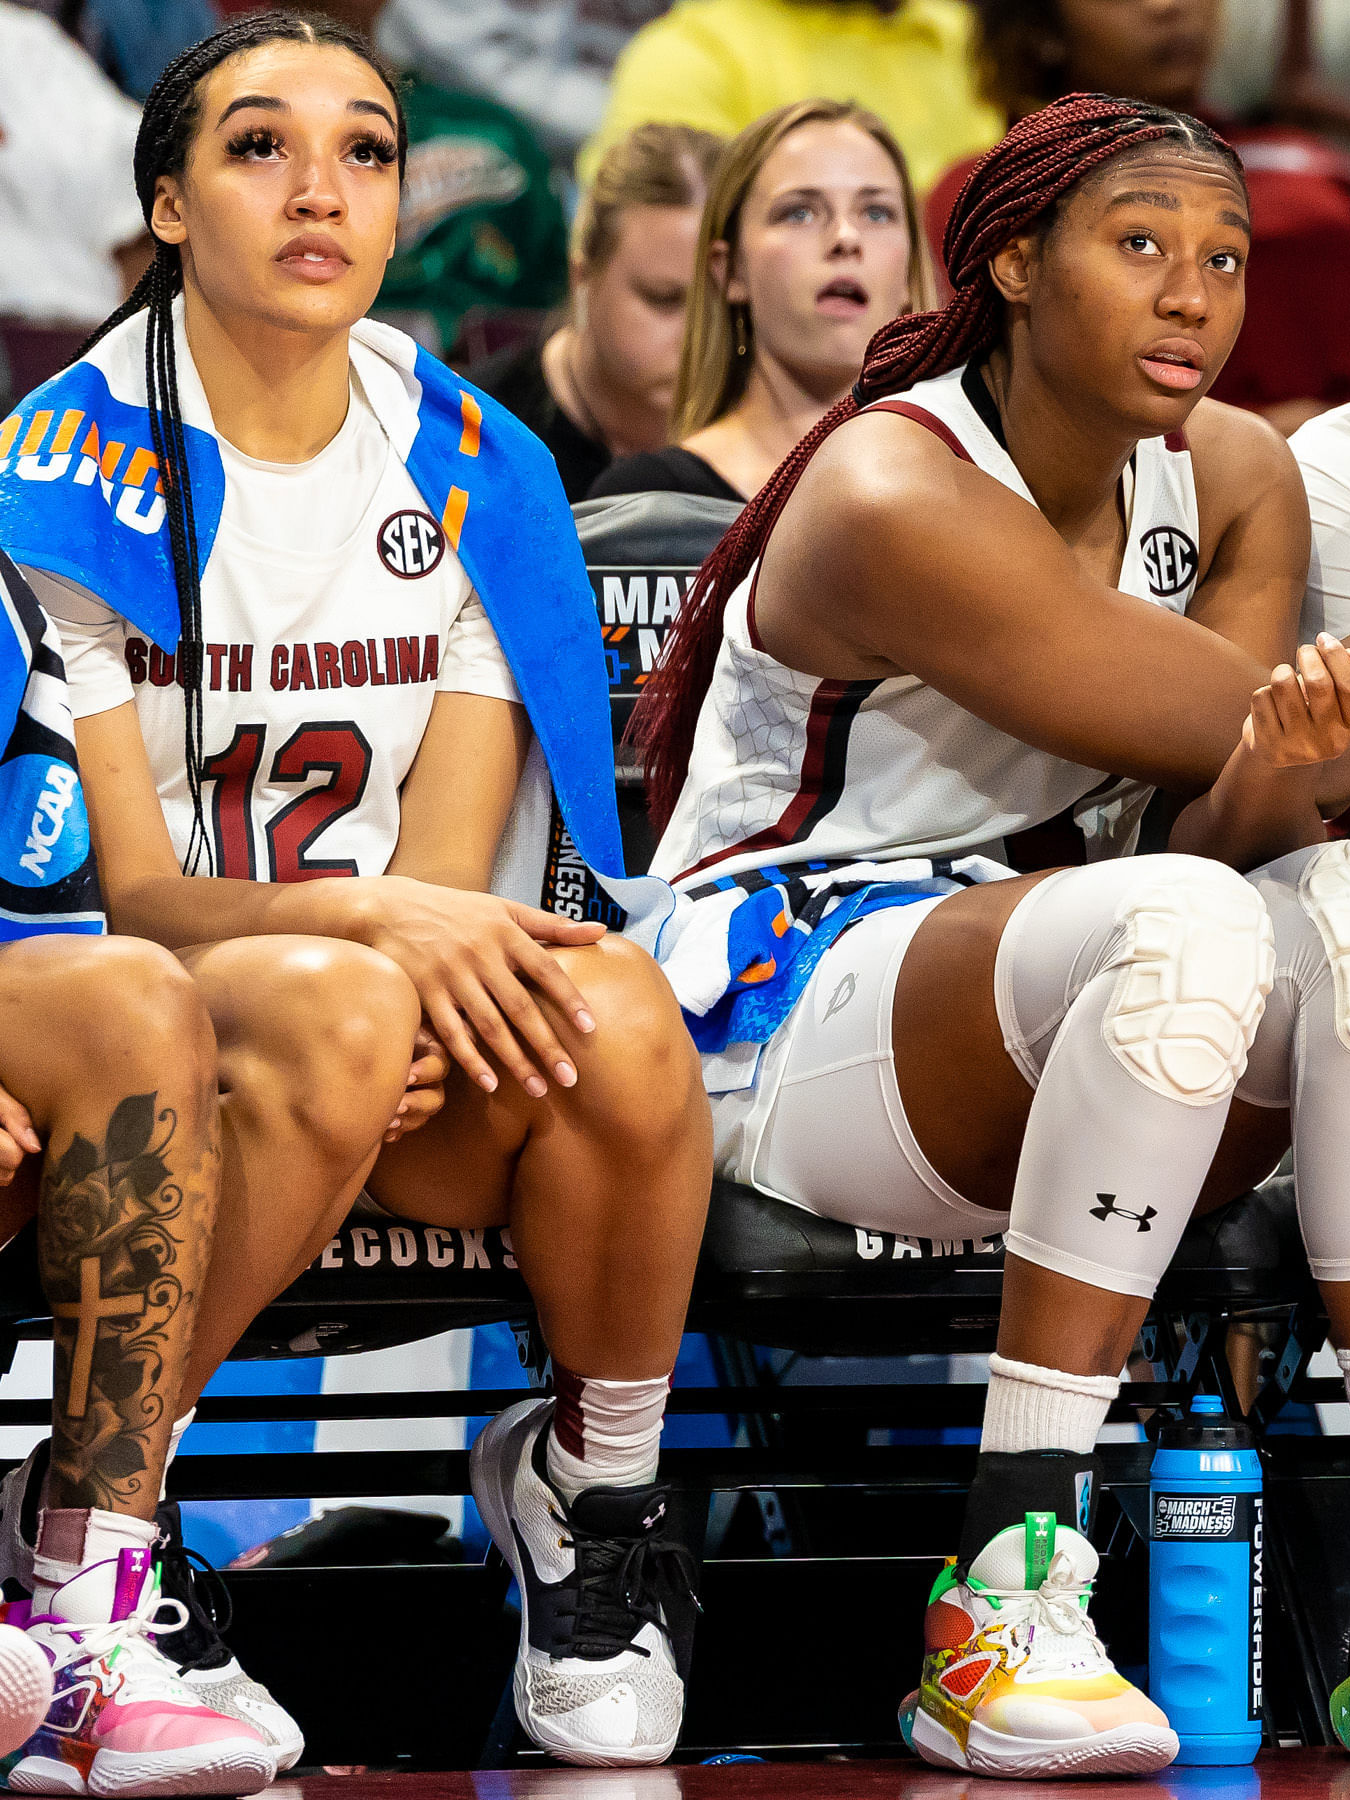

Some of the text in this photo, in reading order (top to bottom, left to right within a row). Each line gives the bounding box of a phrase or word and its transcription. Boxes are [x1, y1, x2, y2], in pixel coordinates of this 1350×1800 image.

[382, 514, 440, 573] SEC
[1142, 531, 1193, 591] SEC
[270, 634, 439, 692] CAROLINA
[19, 764, 79, 880] NCAA
[200, 720, 373, 883] 12
[1167, 1501, 1211, 1516] MARCH
[1171, 1516, 1232, 1530] MADNESS
